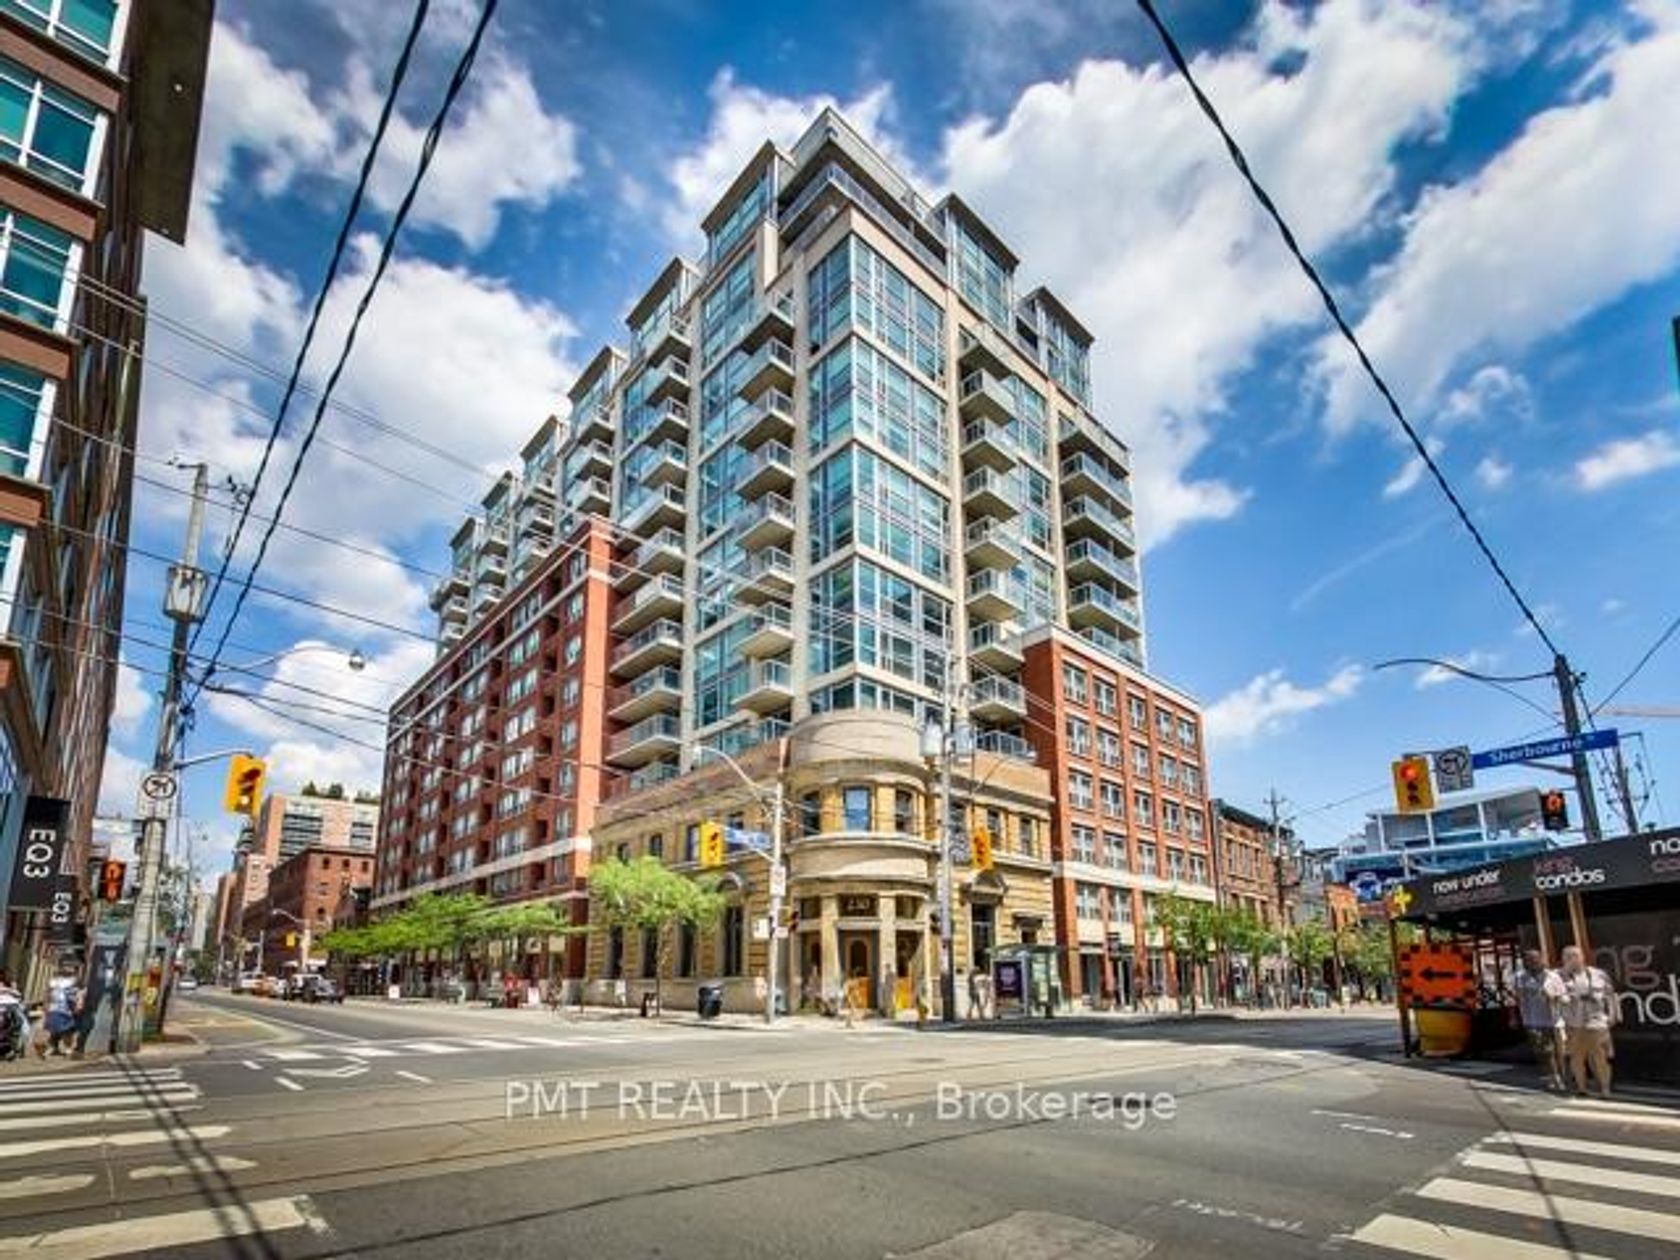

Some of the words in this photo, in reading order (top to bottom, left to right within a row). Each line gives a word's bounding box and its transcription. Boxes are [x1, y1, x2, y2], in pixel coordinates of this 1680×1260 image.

[1488, 738, 1582, 763] Sherbourne
[23, 829, 56, 878] EQ3
[1432, 878, 1459, 895] now
[1535, 866, 1606, 889] condos
